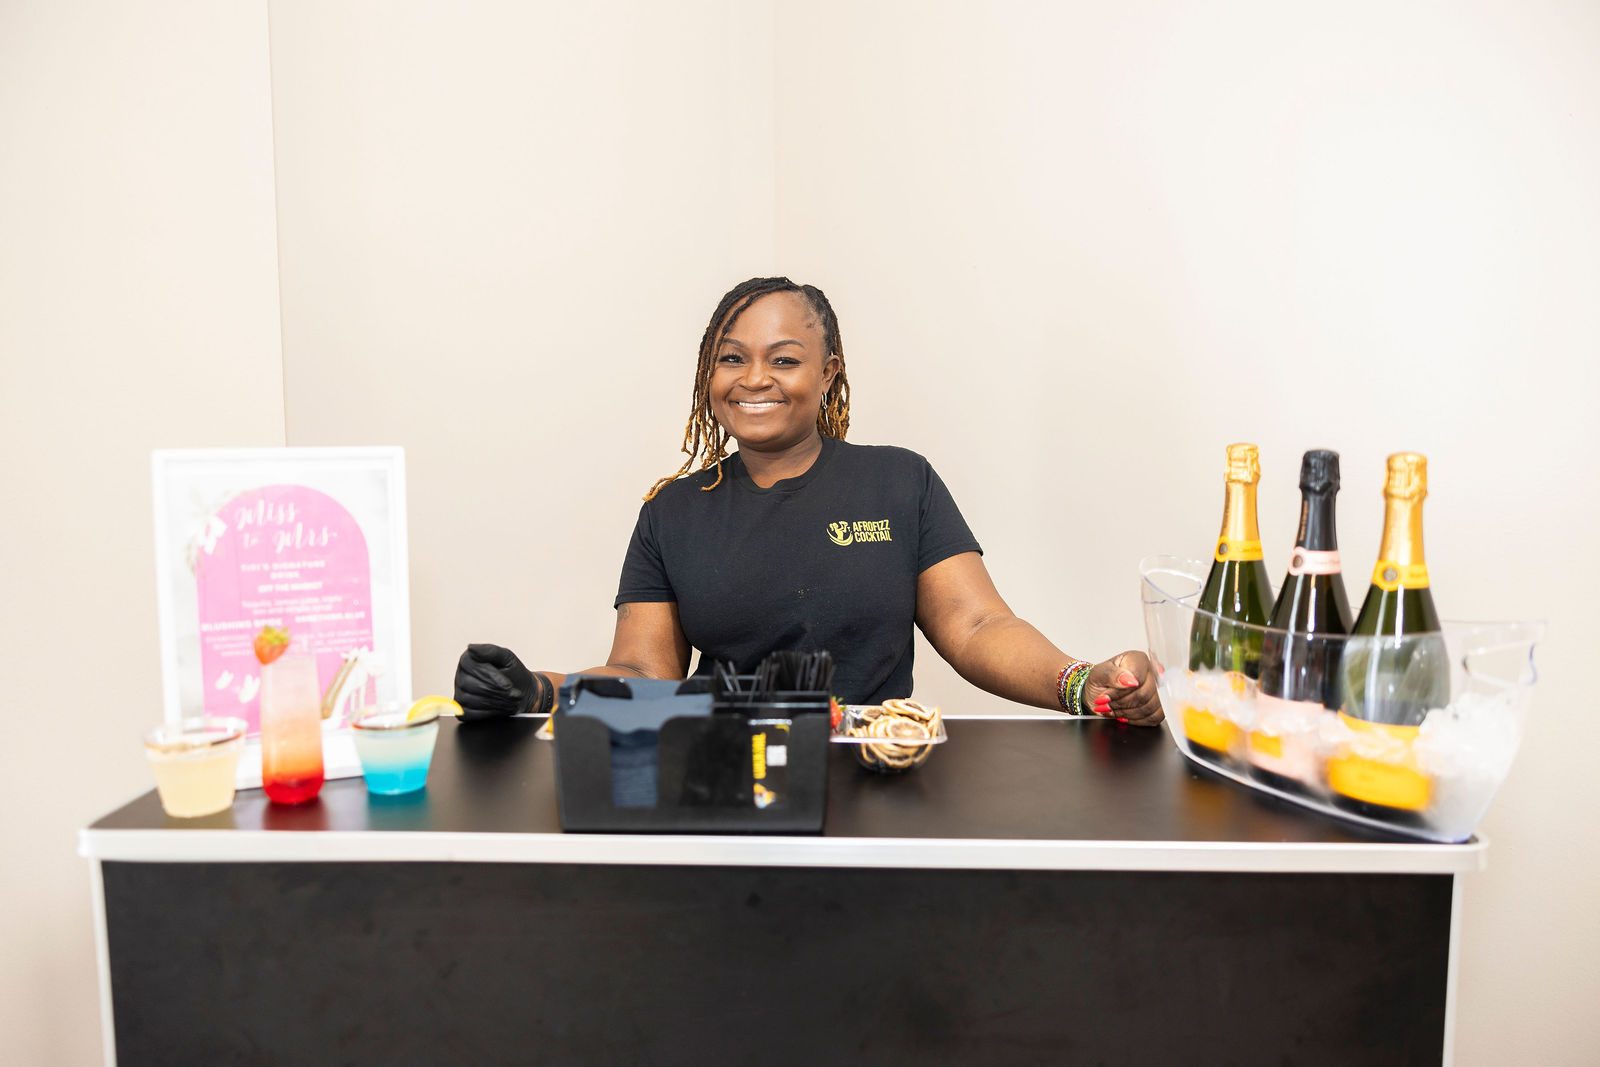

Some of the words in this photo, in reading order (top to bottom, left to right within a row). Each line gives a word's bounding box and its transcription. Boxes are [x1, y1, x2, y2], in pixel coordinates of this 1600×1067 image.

[234, 499, 299, 530] Miss
[852, 519, 891, 532] AFROFIZZ
[242, 532, 260, 549] to
[854, 531, 893, 543] COCKTAIL
